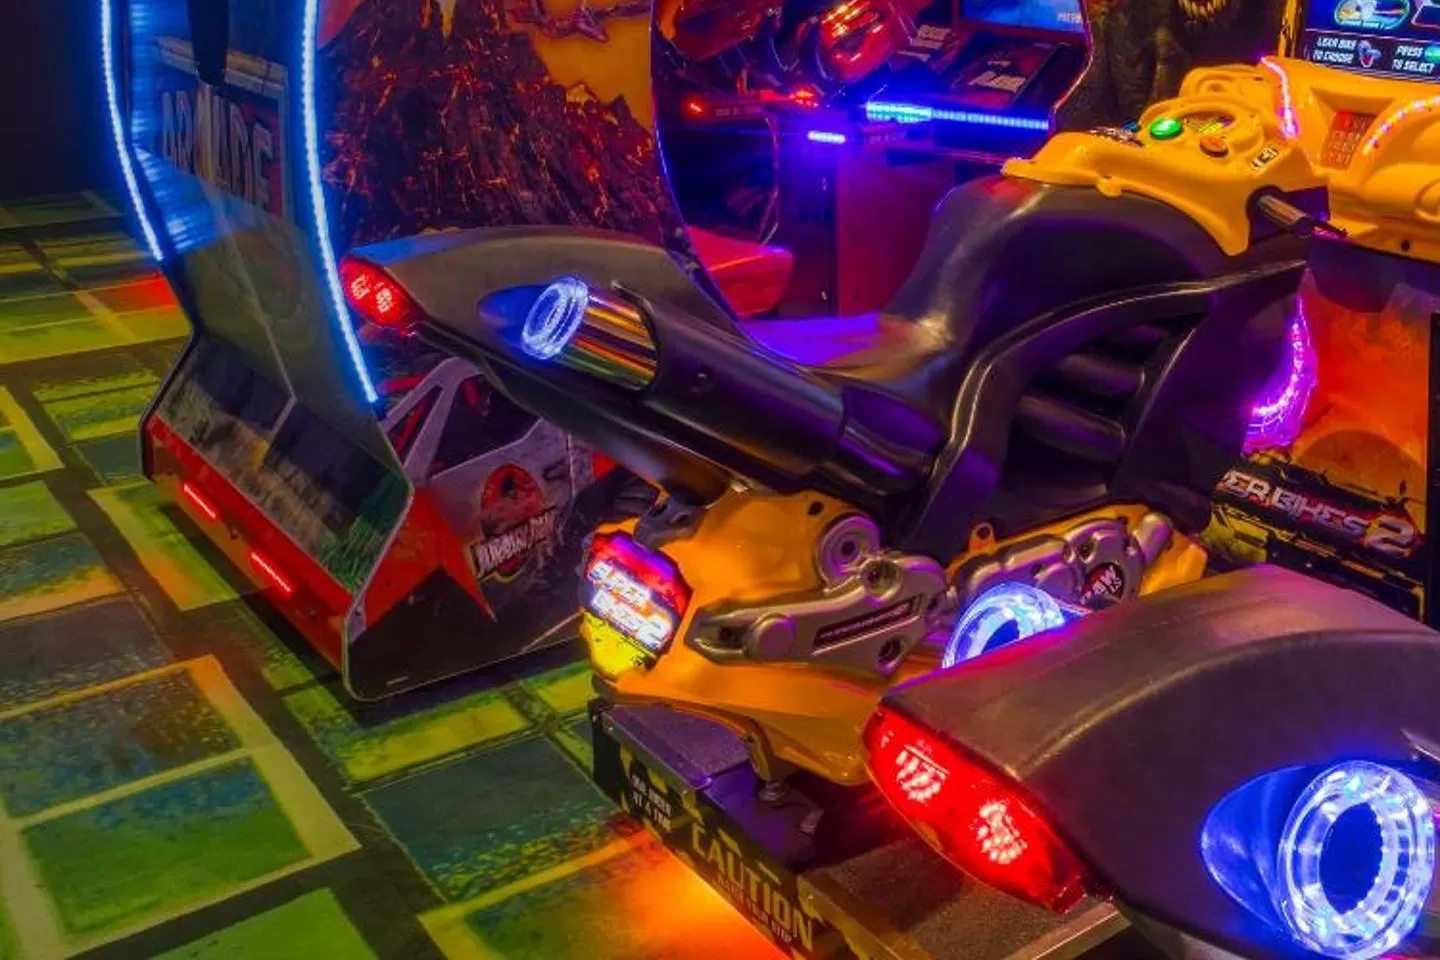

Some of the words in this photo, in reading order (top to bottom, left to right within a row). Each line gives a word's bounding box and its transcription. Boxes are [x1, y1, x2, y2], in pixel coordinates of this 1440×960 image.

[1270, 486, 1371, 538] BIKES
[1362, 513, 1417, 559] 2
[691, 821, 814, 953] CAUTION
